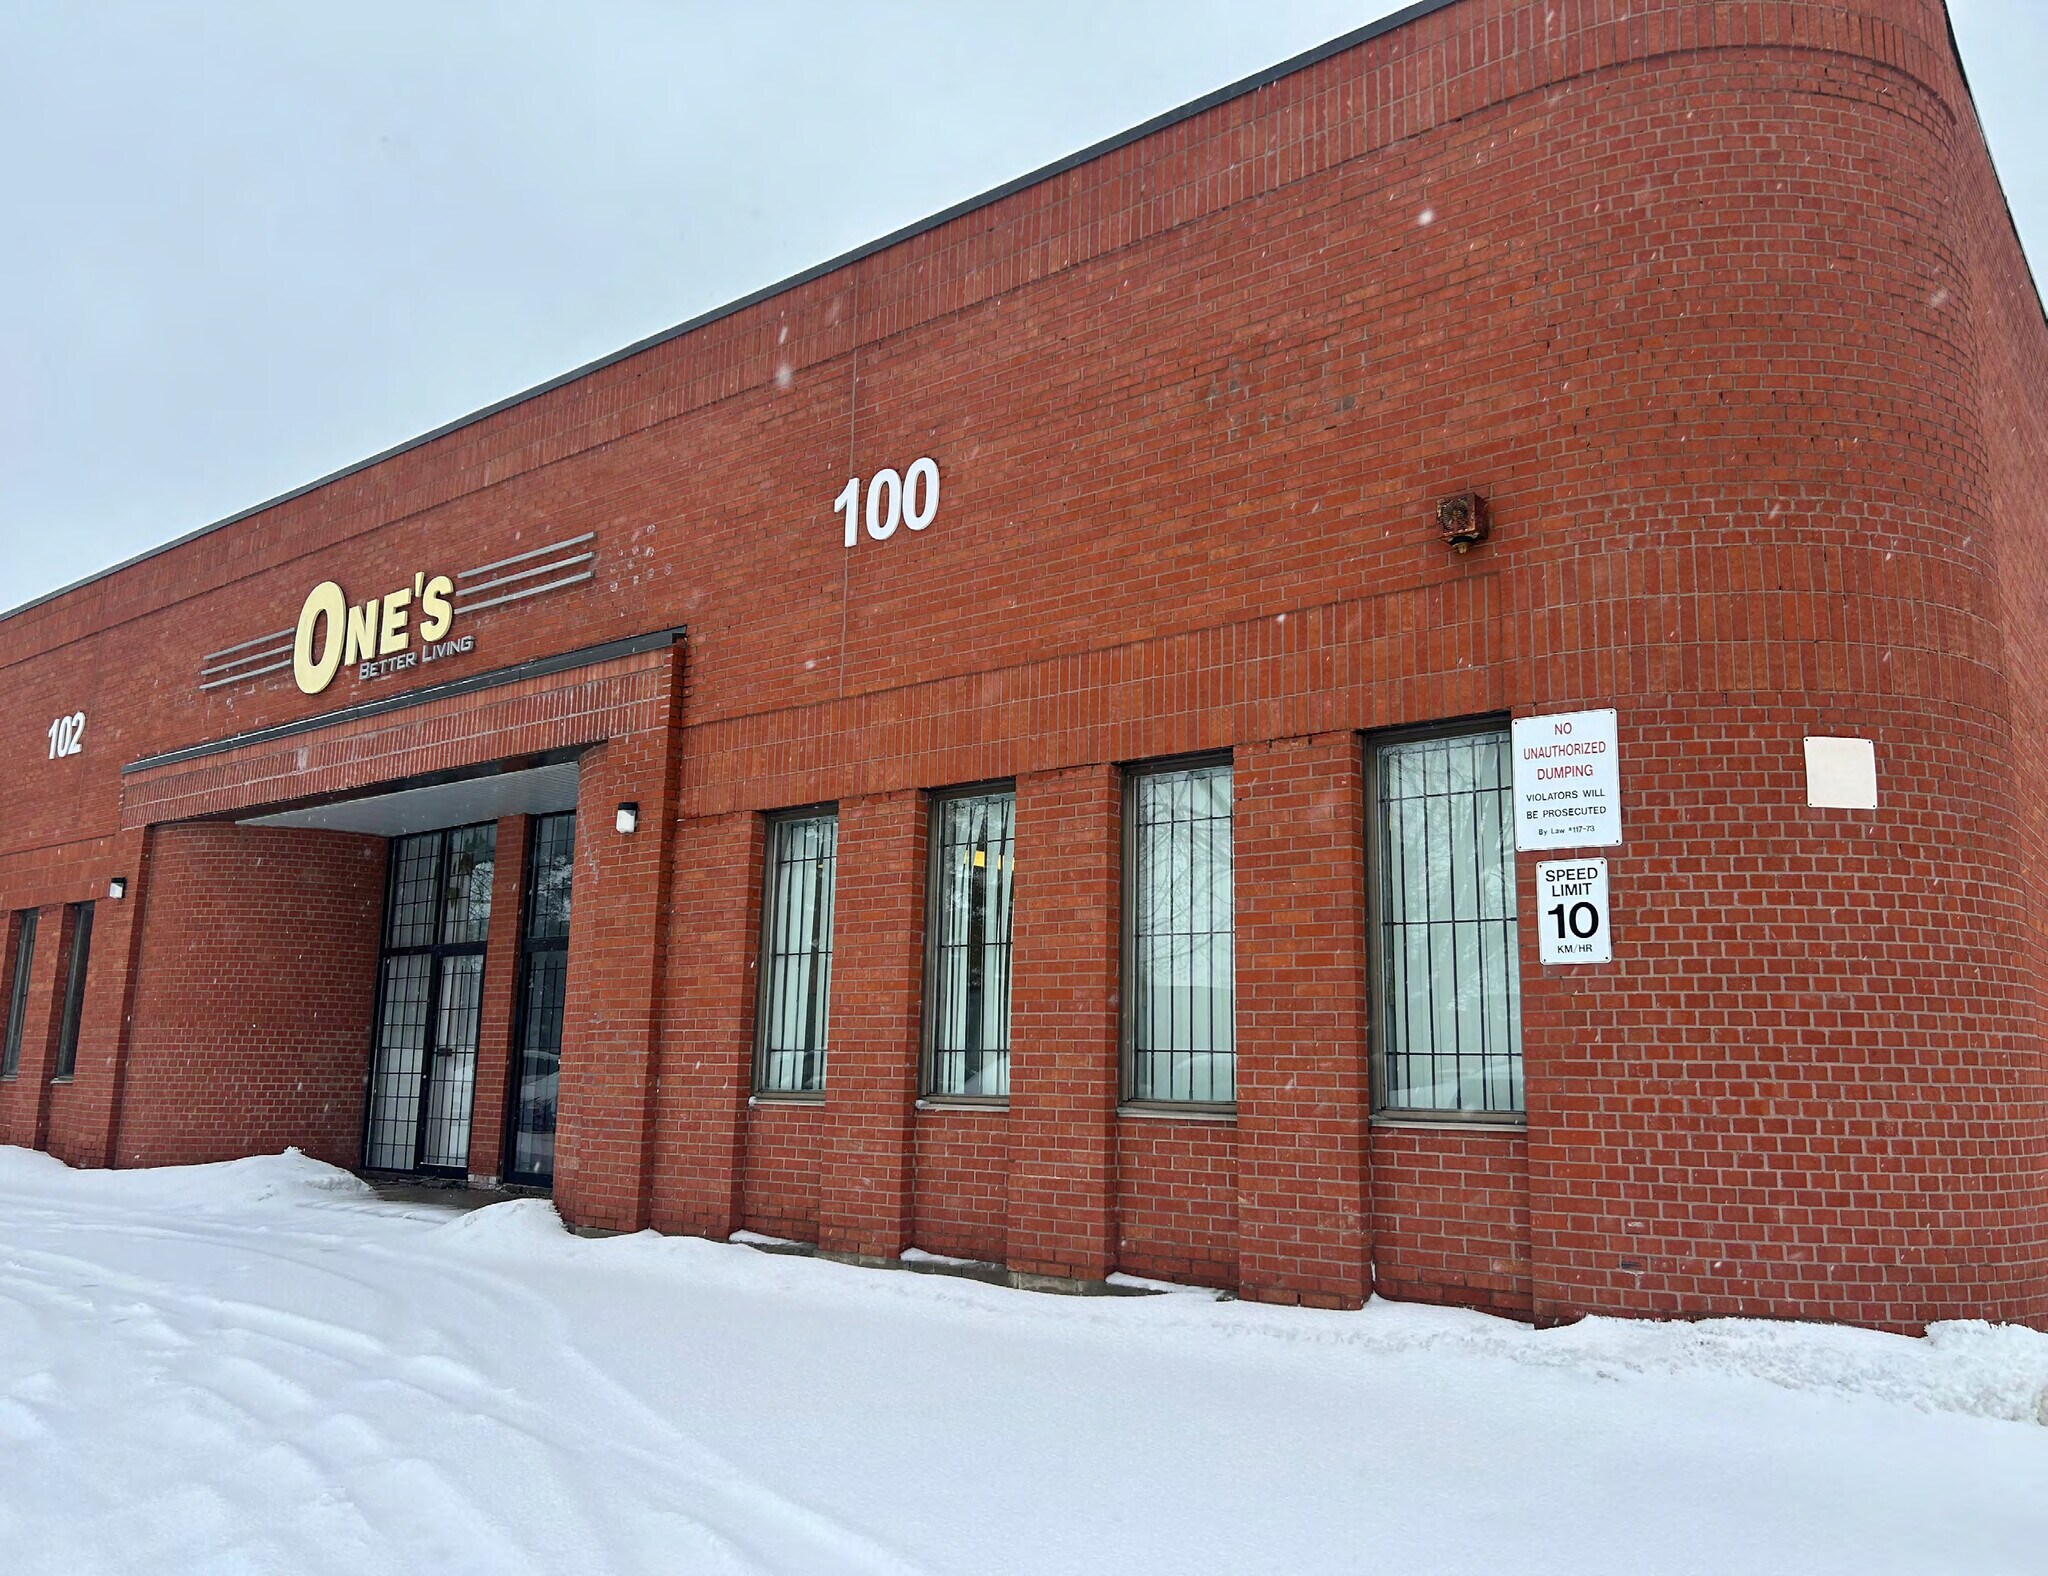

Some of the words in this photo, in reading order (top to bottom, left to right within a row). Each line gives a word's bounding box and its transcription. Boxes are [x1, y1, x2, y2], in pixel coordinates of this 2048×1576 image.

[834, 457, 940, 548] 100
[293, 571, 455, 695] ONE'S
[359, 653, 418, 680] BETTER
[422, 635, 475, 662] LIVING
[48, 711, 86, 760] 102
[1554, 722, 1572, 736] NO
[1523, 741, 1606, 760] UNAUTHORIZED
[1537, 764, 1594, 781] DUMPING
[1526, 790, 1578, 801] VIOLATORS
[1583, 788, 1606, 797] WILL
[1526, 810, 1538, 820] BE
[1542, 805, 1607, 818] PROSECUTED
[1538, 828, 1547, 836] By
[1550, 827, 1565, 835] Law
[1545, 867, 1598, 883] SPEED
[1552, 883, 1592, 897] LIMIT
[1547, 901, 1600, 939] 10
[1557, 943, 1593, 954] KM/HR
